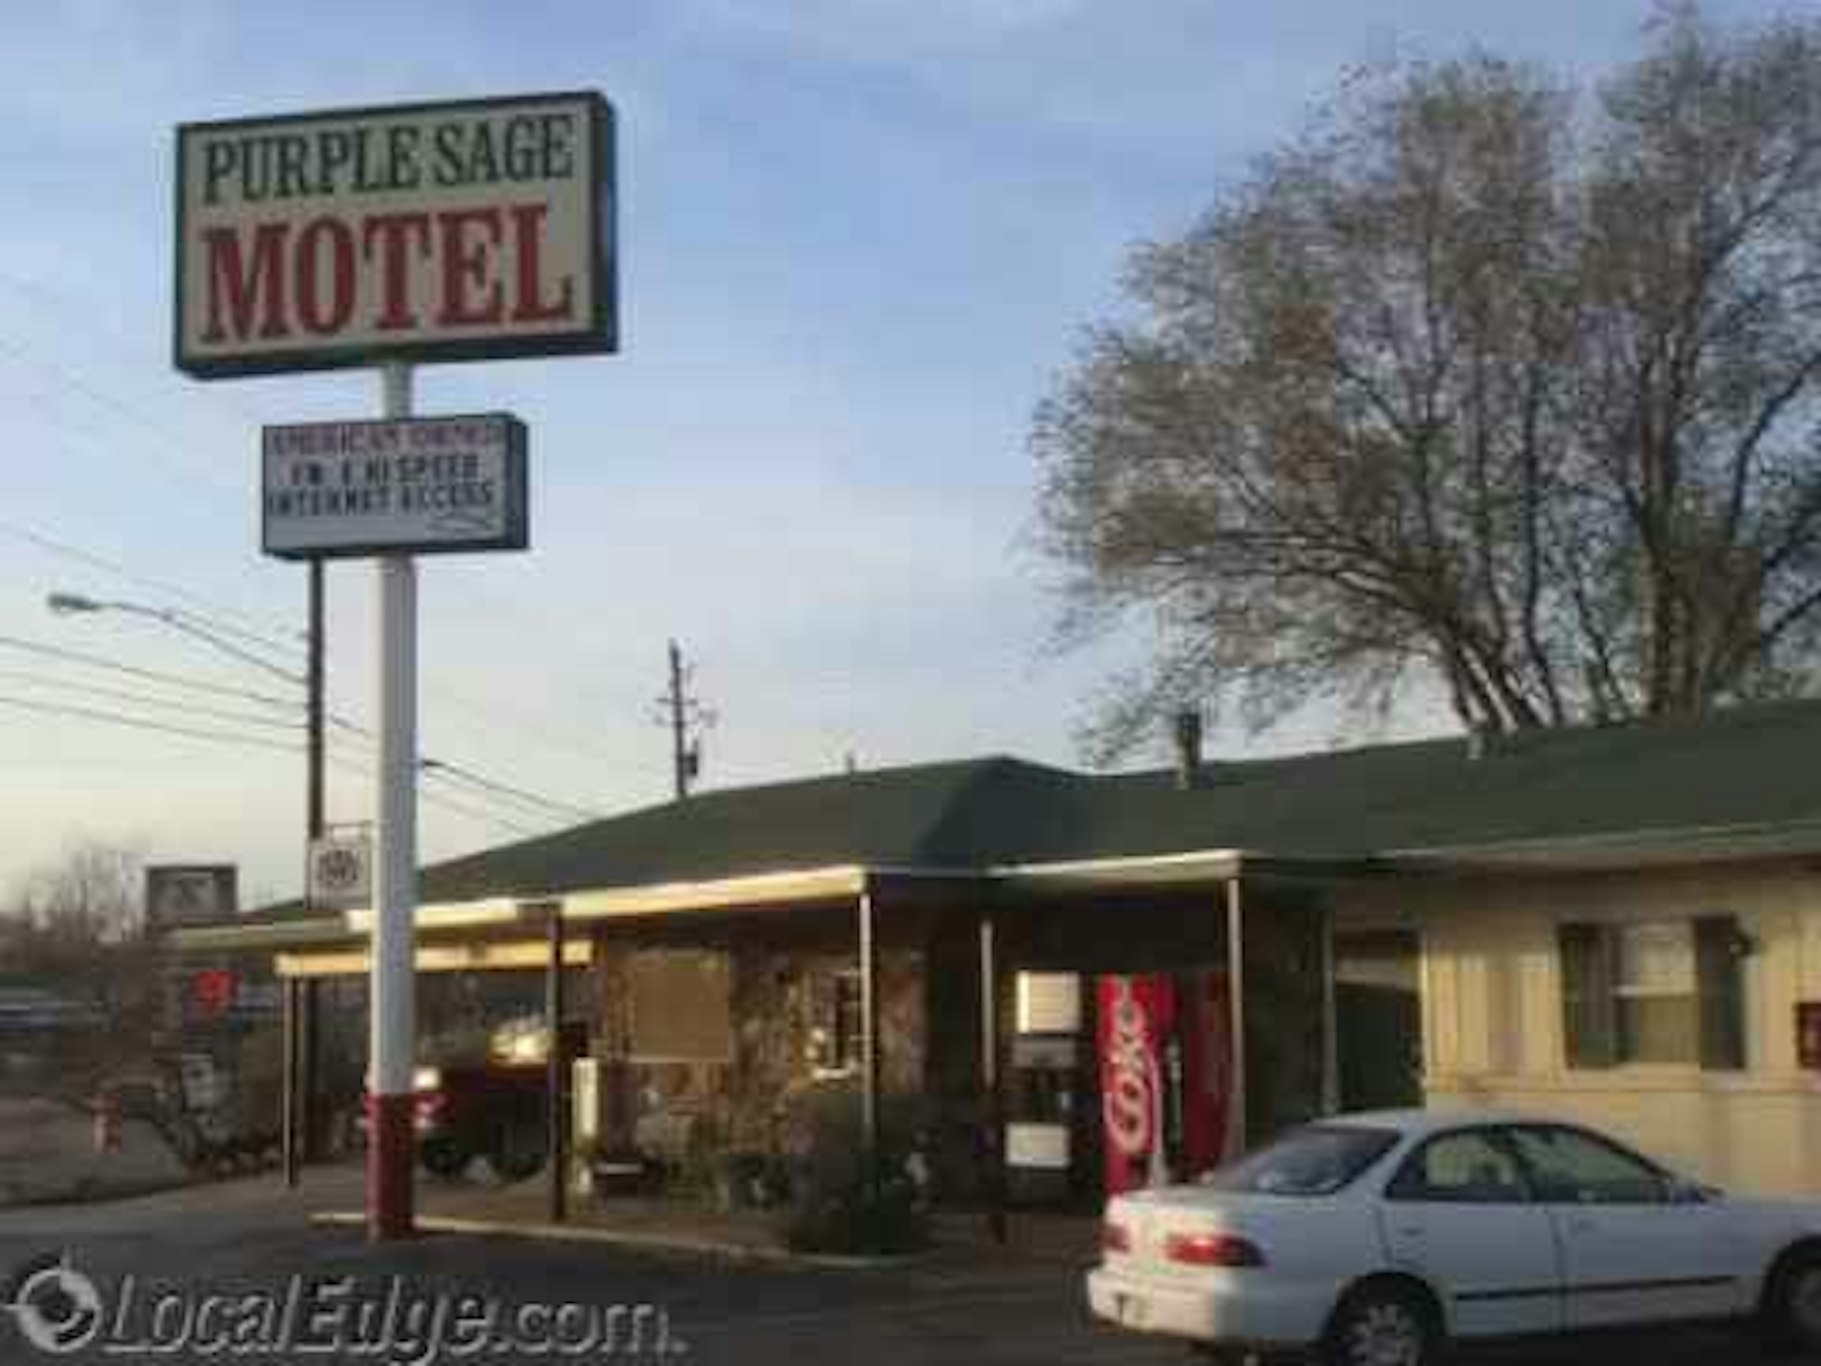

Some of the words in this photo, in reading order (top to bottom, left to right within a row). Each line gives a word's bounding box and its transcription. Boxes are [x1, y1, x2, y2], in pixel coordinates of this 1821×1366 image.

[203, 125, 421, 204] PURPLE
[433, 112, 574, 188] SAGE
[202, 203, 574, 343] MOTEL
